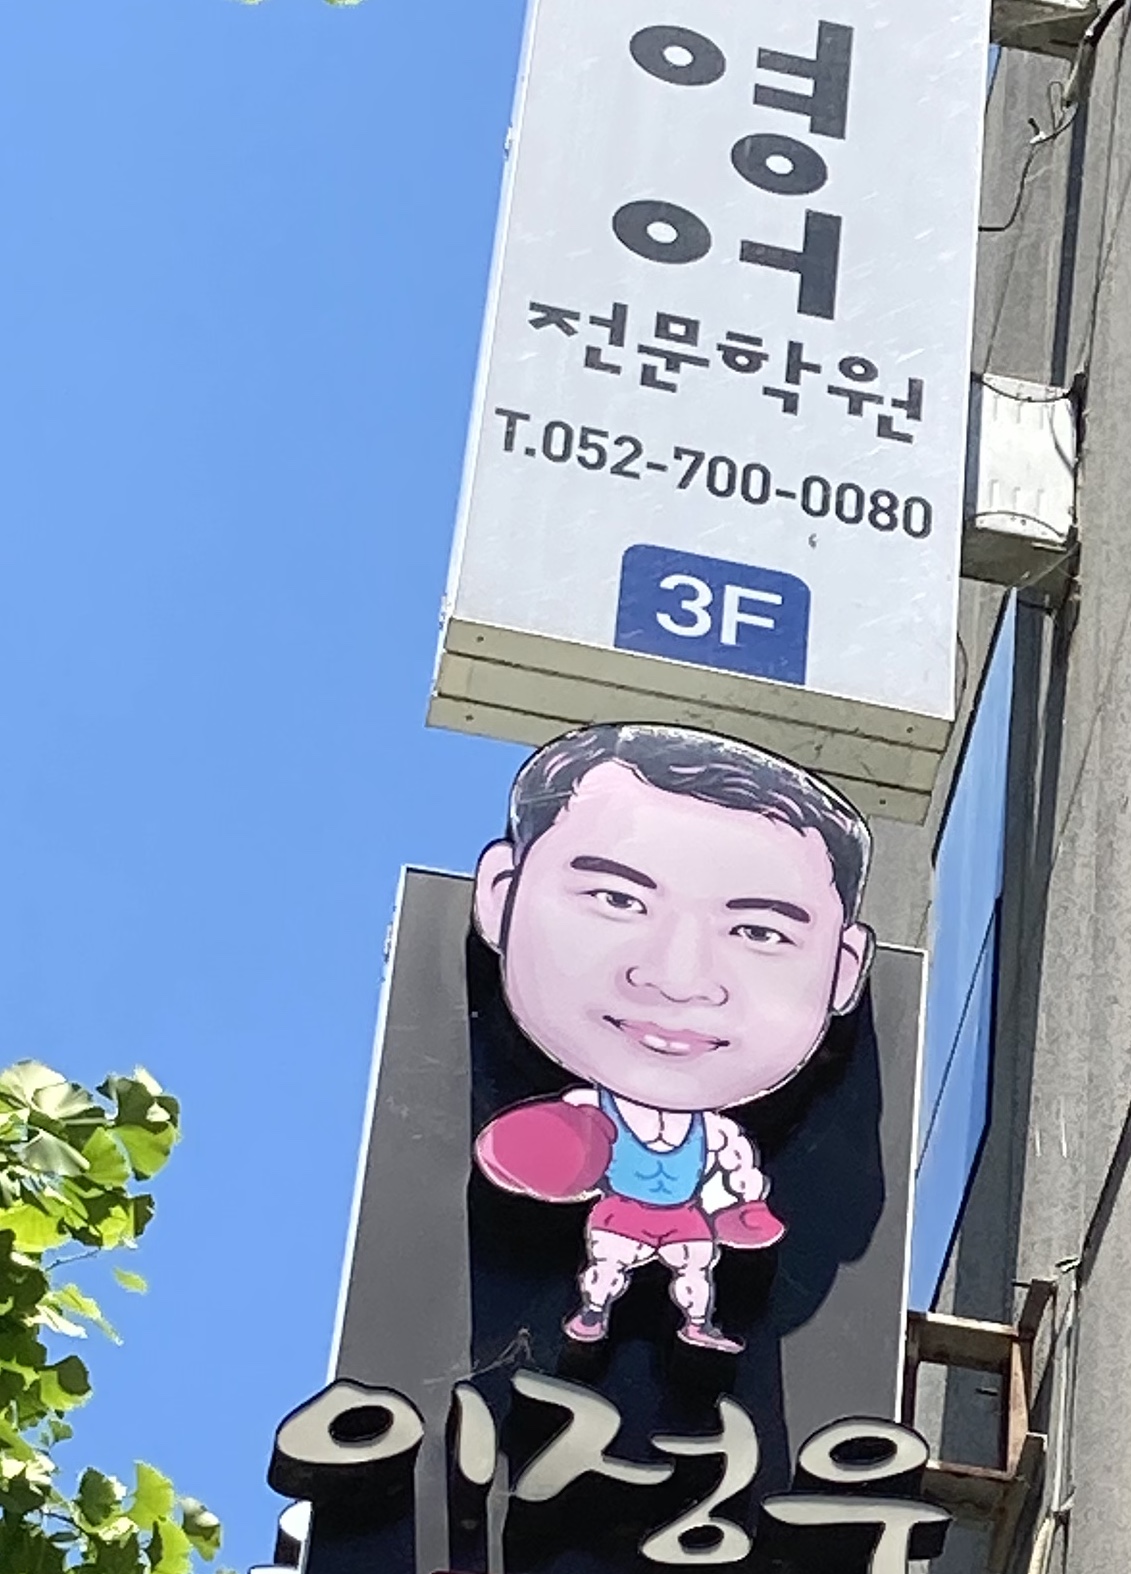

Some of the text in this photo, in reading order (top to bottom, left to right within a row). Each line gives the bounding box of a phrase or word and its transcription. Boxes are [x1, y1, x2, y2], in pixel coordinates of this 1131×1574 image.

[611, 19, 855, 321] 영어
[527, 300, 923, 445] 전문학원
[494, 406, 933, 541] T.052-700-0080
[655, 573, 783, 648] 3F
